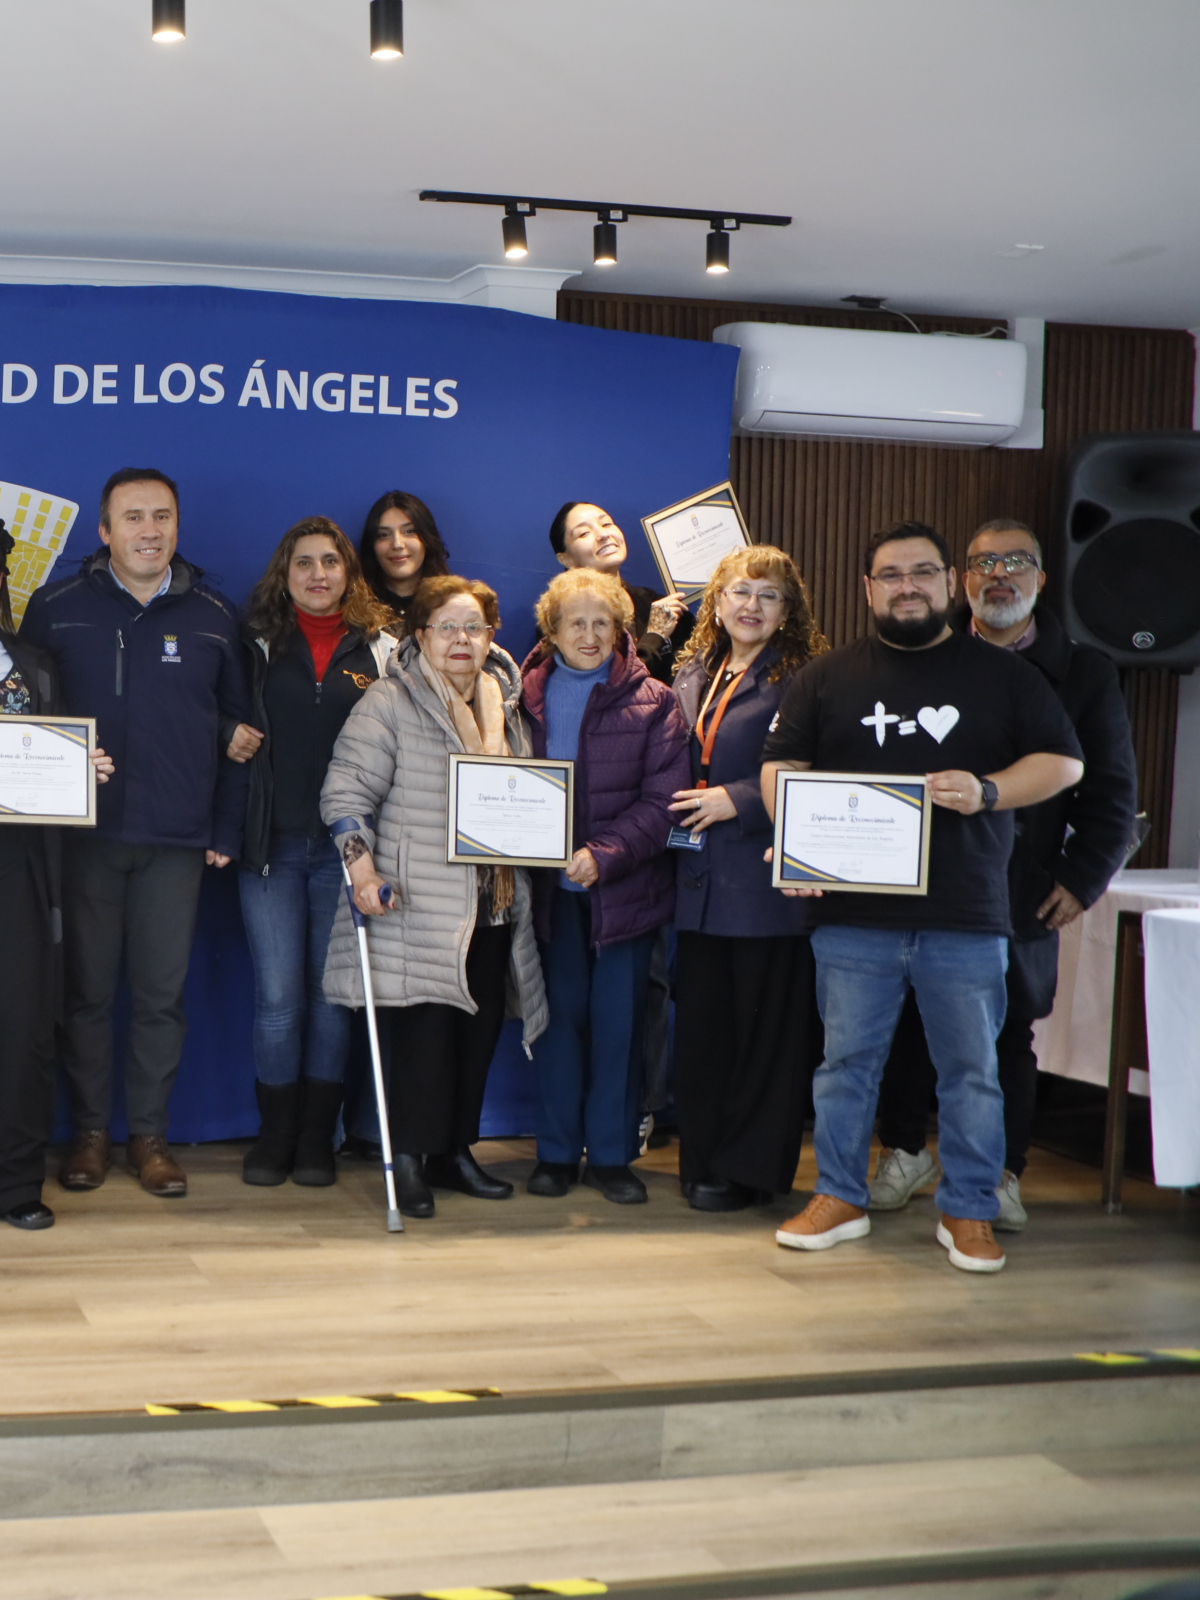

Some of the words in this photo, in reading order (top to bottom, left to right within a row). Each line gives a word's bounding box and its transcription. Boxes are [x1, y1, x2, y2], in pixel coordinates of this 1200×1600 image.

[53, 364, 118, 405] DE
[133, 362, 225, 405] LOS
[237, 359, 459, 419] ÁNGELES
